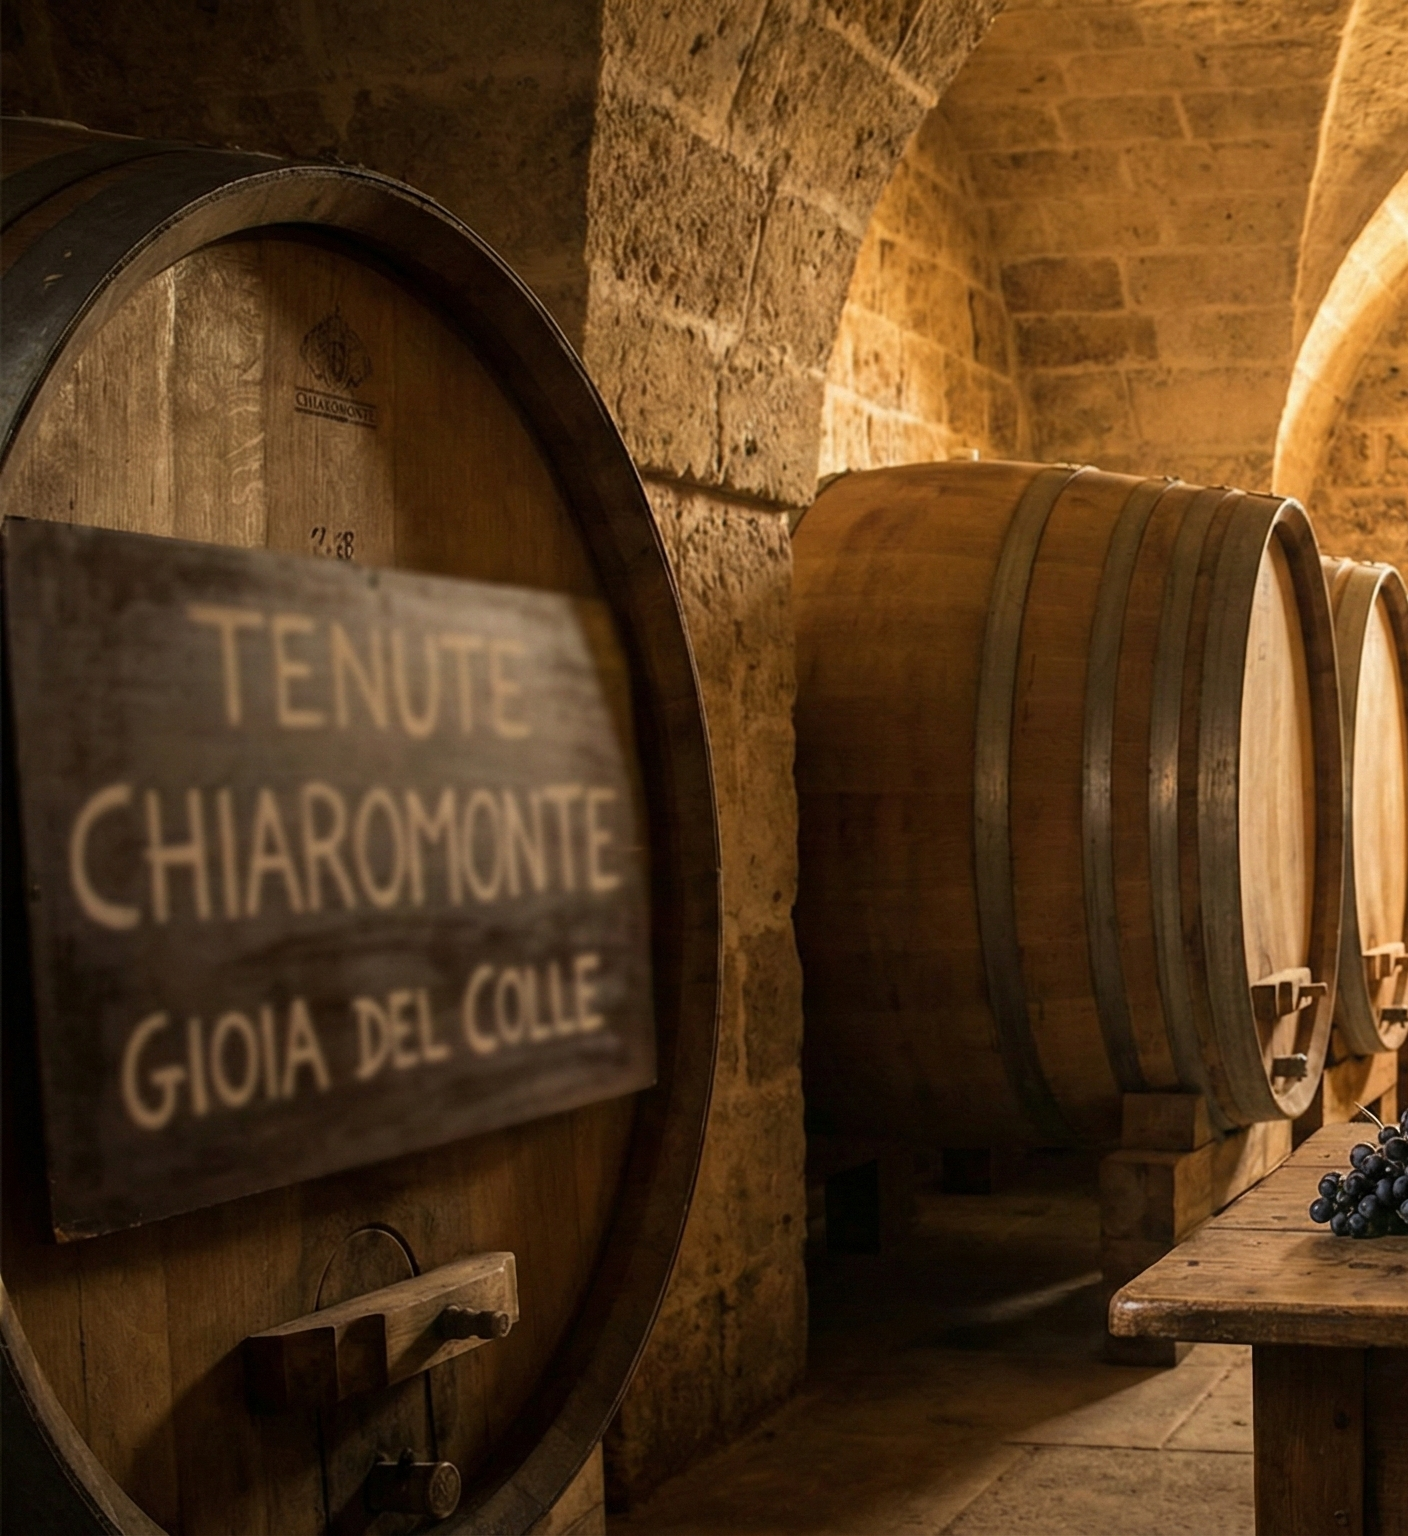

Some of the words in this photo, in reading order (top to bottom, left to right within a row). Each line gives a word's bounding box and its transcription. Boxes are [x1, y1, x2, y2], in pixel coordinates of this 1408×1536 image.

[187, 604, 535, 741] TENUTE
[69, 782, 624, 932] CHIAROMONTE
[122, 997, 332, 1132] GIOIA
[352, 986, 452, 1082] DEL
[463, 952, 607, 1057] COLLE
